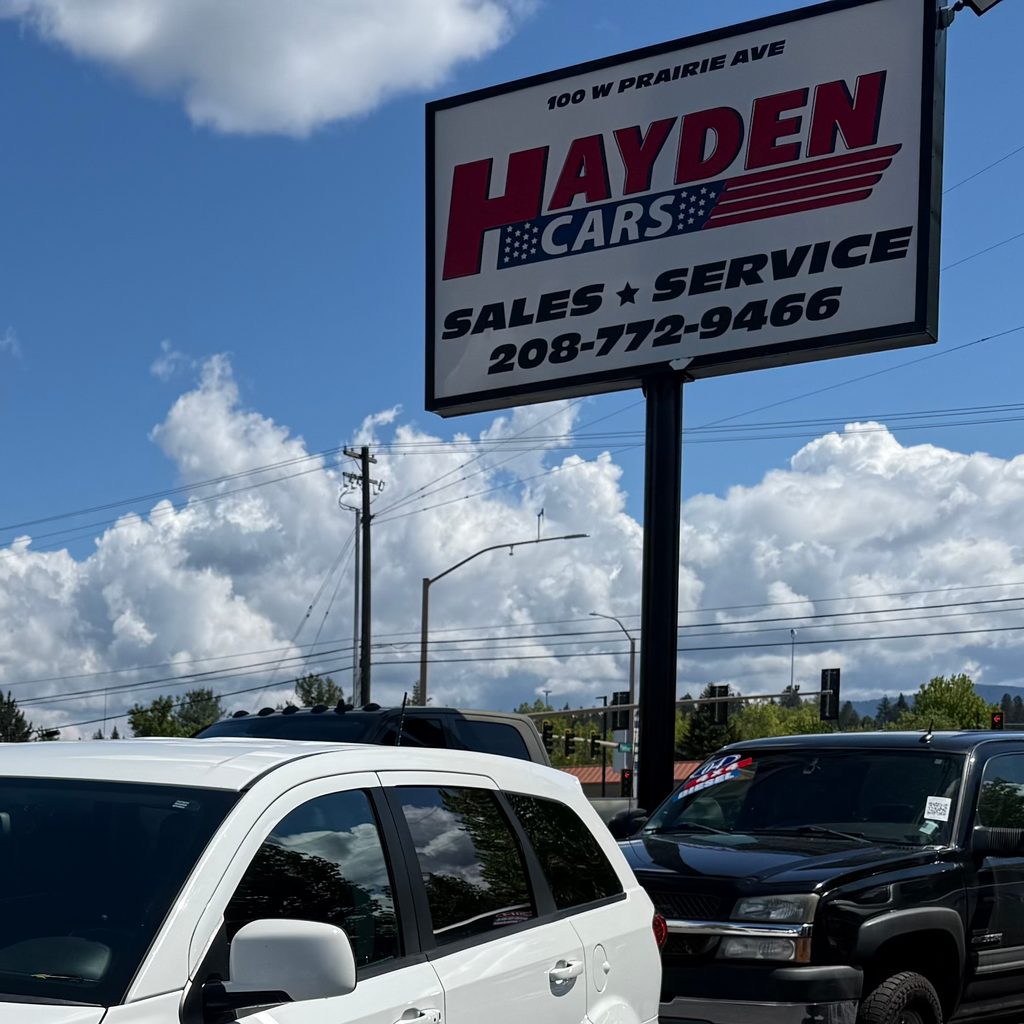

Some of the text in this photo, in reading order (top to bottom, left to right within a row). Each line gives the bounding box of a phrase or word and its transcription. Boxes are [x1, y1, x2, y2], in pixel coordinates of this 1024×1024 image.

[547, 39, 786, 110] 100 W PRAIRIE AVE
[442, 70, 887, 280] HAYDEN
[541, 196, 676, 256] CARS
[442, 226, 914, 340] SALES SERVICE
[487, 287, 843, 375] 208-772-9466
[678, 772, 735, 799] DIESEL
